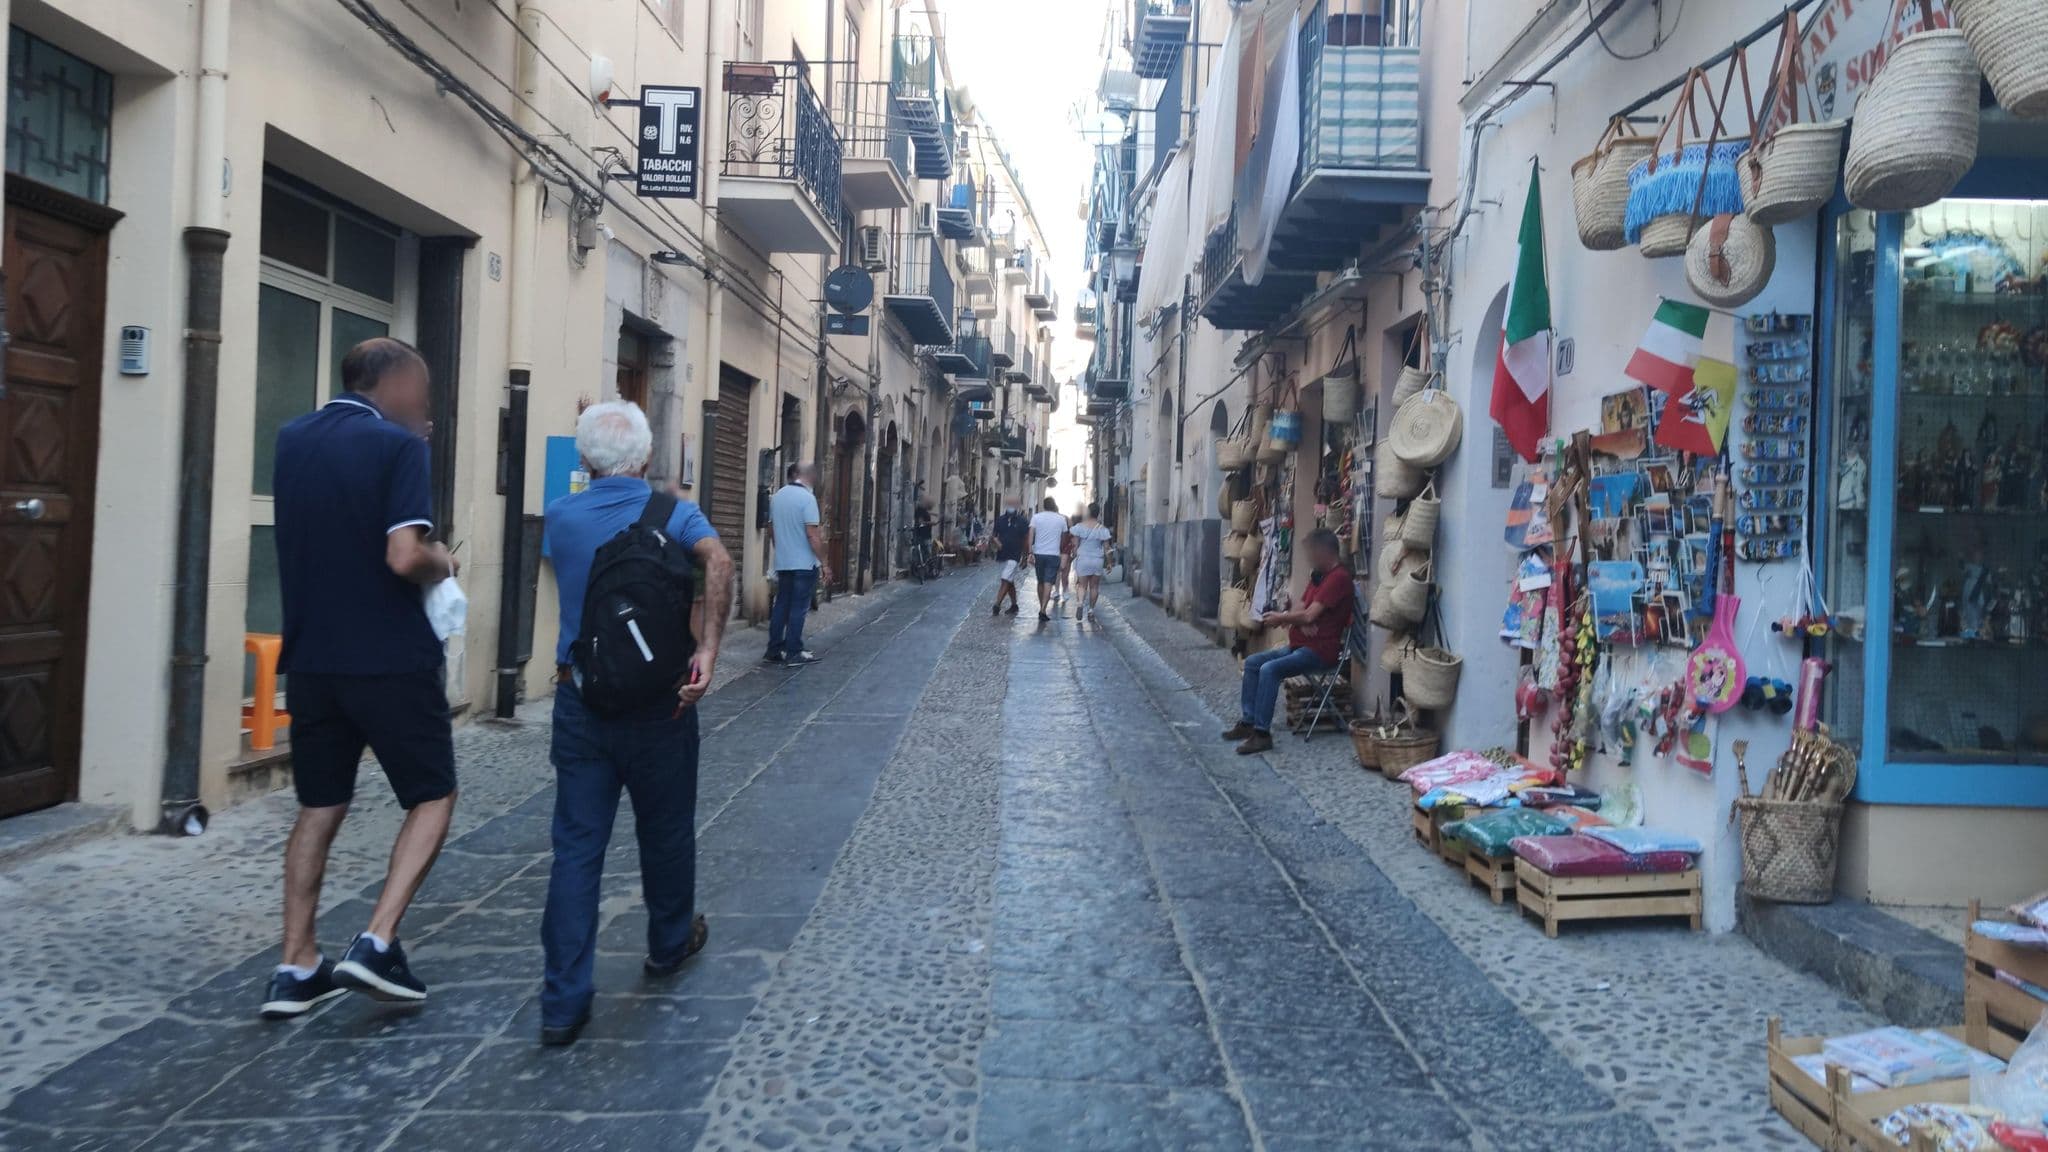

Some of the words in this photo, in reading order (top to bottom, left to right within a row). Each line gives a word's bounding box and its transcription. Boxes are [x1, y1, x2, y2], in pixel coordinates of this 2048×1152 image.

[644, 89, 694, 155] T
[680, 124, 693, 133] RIV.
[642, 158, 692, 172] TABACCHI
[641, 174, 665, 182] VALORI
[665, 175, 692, 184] BOLLATI
[1559, 341, 1572, 370] 70
